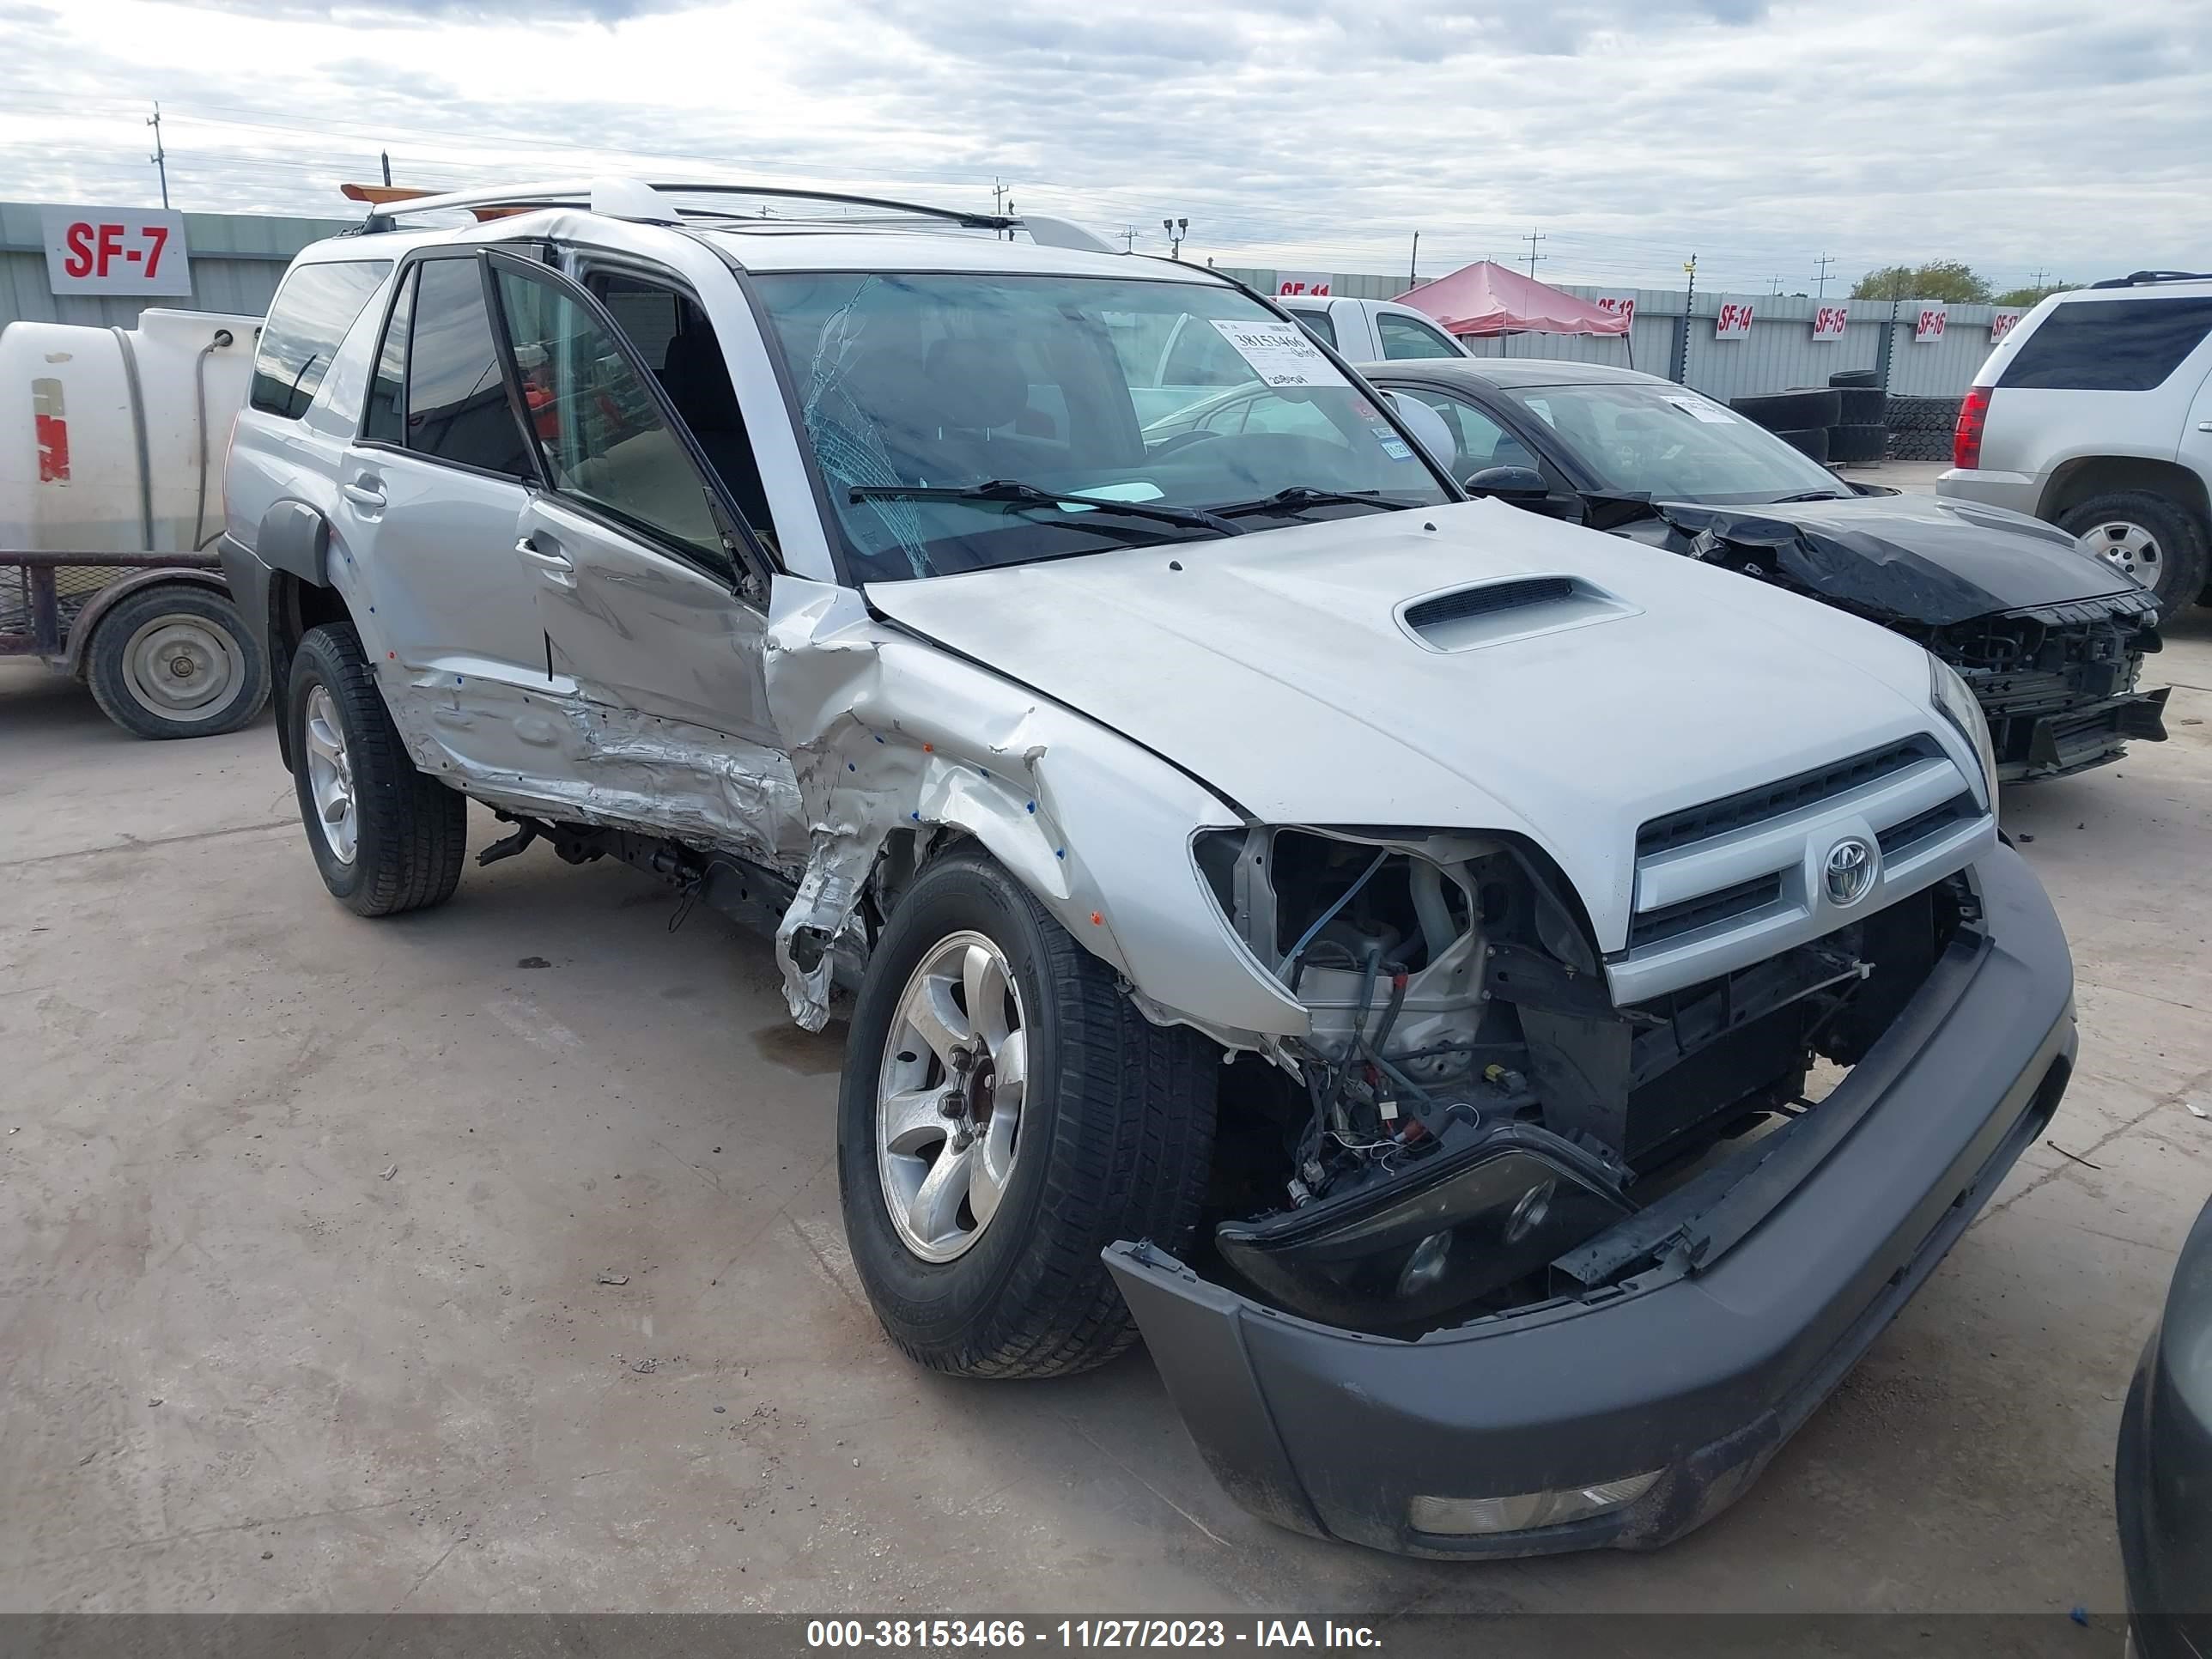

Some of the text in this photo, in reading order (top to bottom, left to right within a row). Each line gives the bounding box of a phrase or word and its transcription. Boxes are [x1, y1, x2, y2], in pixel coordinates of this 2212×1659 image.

[64, 222, 168, 278] SF-7
[1718, 304, 1753, 331] SF-14
[1815, 307, 1847, 333] SF-15
[1917, 311, 1946, 336] SF-16
[1234, 334, 1306, 349] 38153466
